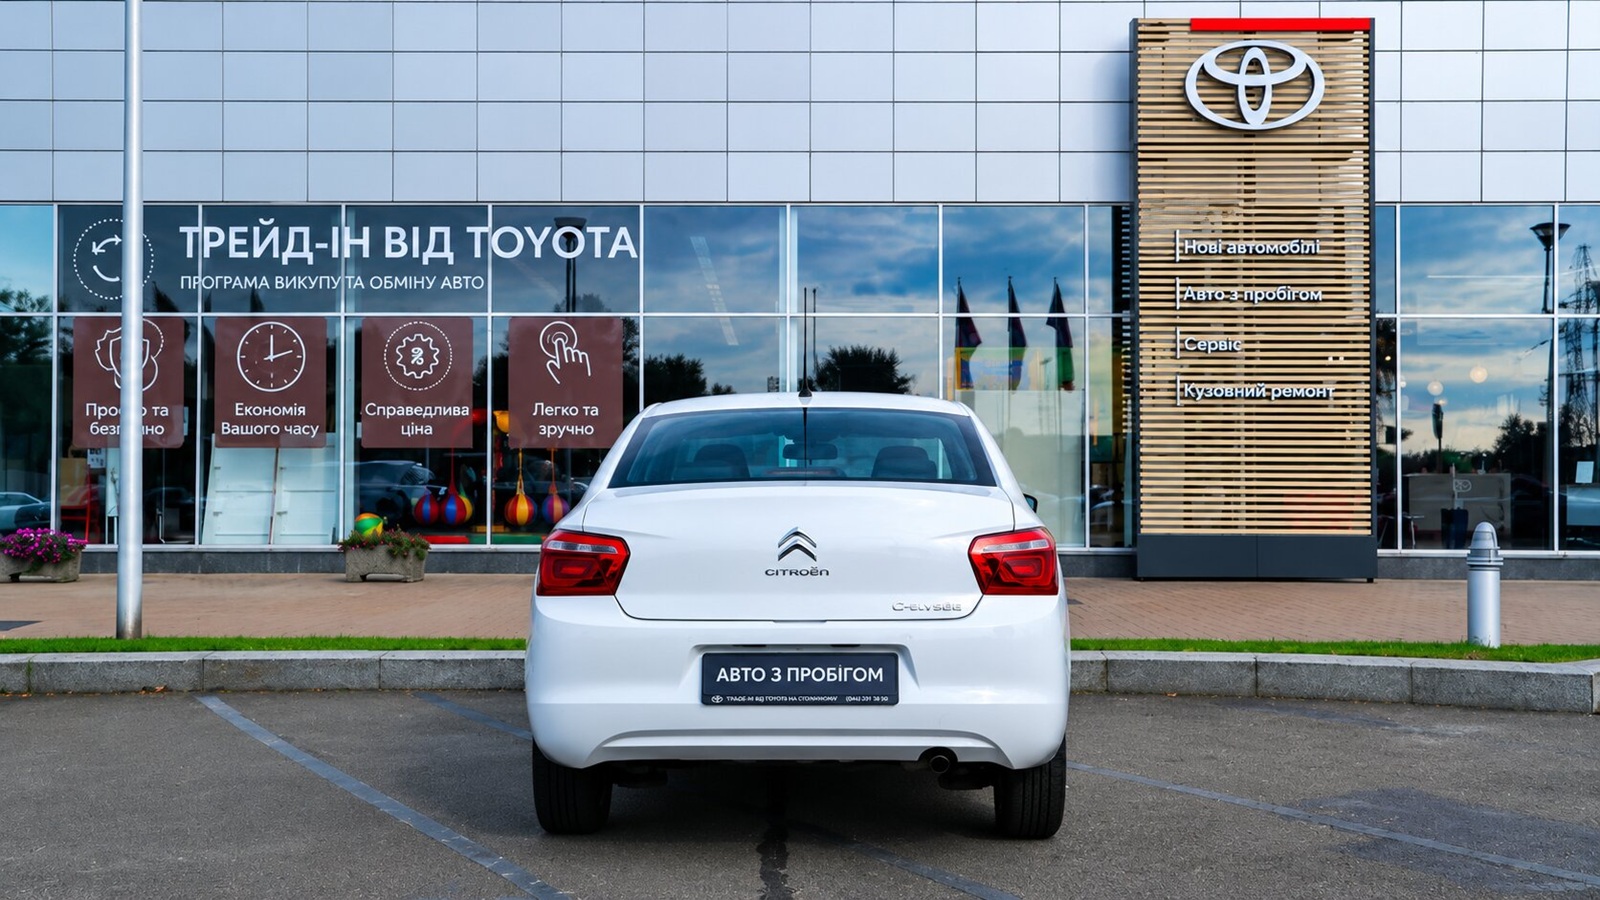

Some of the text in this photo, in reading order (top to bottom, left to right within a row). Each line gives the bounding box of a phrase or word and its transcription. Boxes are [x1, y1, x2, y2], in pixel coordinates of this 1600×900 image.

[179, 218, 638, 265] ТРЕЙД-ІН ВІД TOYOTA
[1184, 239, 1320, 254] Нові автомобілі
[180, 275, 485, 290] ПРОГРАМА ВИКУПУ ТА ОБМІНУ АВТО
[1184, 286, 1322, 304] Авто з пробігом
[1184, 337, 1243, 354] Сервіс
[1184, 383, 1336, 400] Кузовний ремонт
[85, 403, 169, 420] Проо та
[235, 402, 306, 416] Економія
[365, 402, 470, 419] Справедлива
[532, 402, 599, 416] Легко та
[221, 422, 319, 438] Вашого часу
[401, 422, 433, 437] ціна
[539, 425, 595, 438] зручно
[716, 667, 766, 682] АВТО
[787, 664, 884, 682] ПРОБІГОМ
